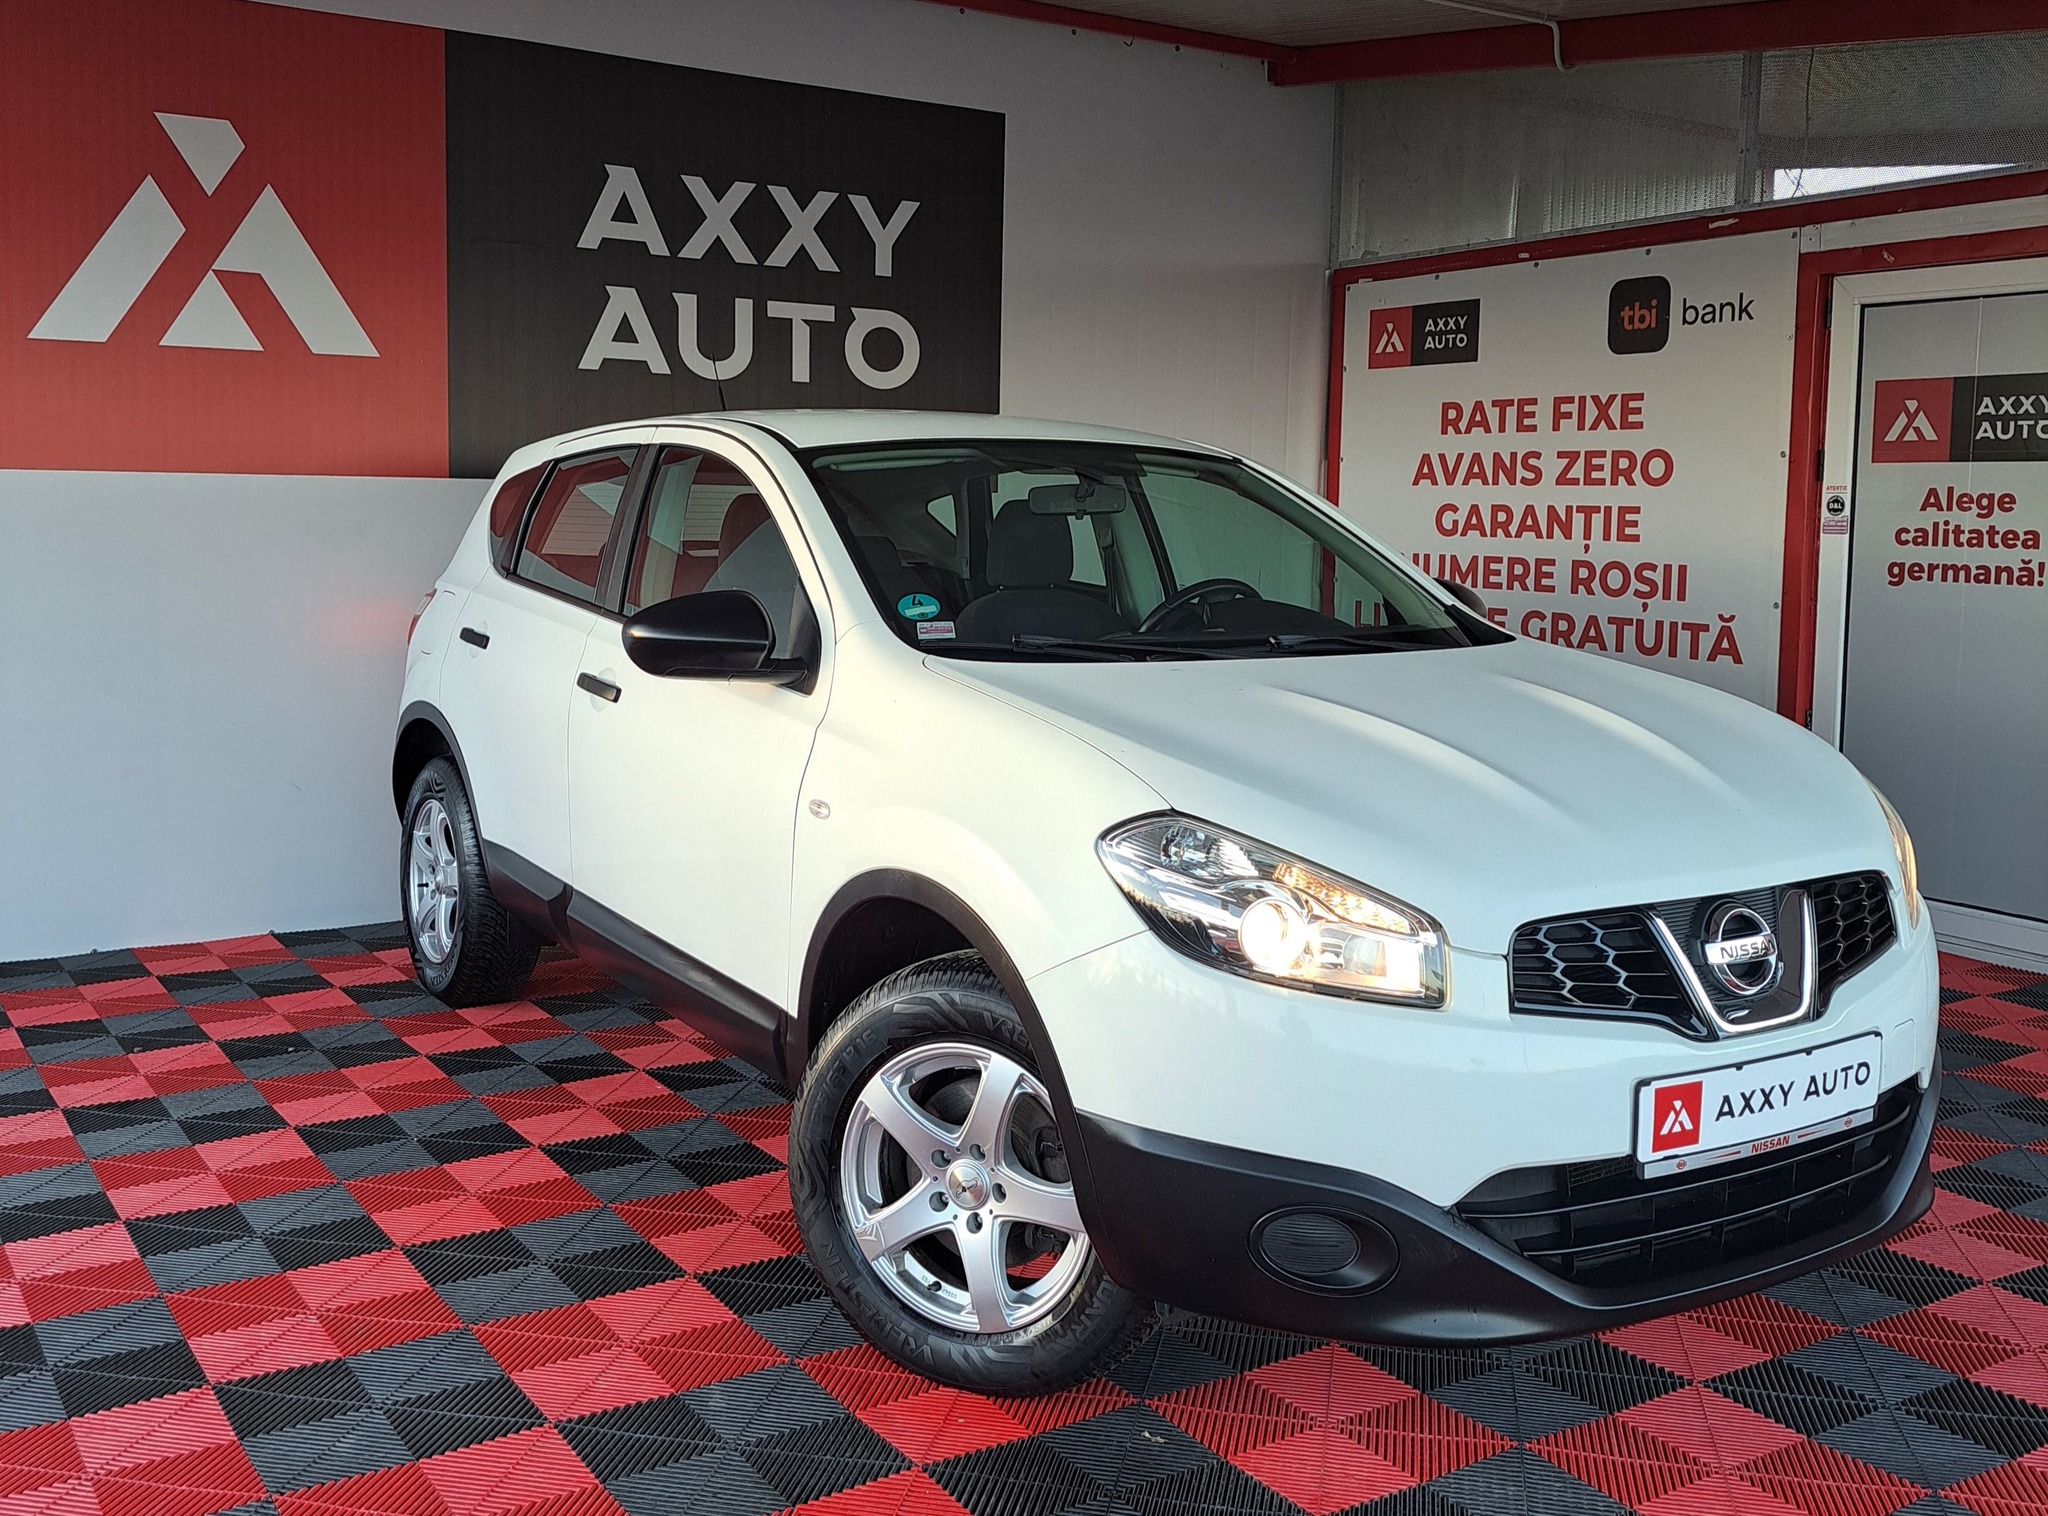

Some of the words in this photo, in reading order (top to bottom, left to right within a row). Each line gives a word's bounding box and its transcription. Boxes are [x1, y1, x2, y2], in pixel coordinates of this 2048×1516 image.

[577, 163, 920, 277] AXXY
[1424, 315, 1468, 333] AXXY
[1620, 299, 1658, 331] tbi
[1681, 292, 1755, 326] bank
[578, 285, 920, 390] AUTO
[1424, 333, 1468, 350] AUTO
[1440, 398, 1538, 435] RATE
[1551, 393, 1645, 432] FIXE
[1976, 395, 2048, 416] AXXY
[1975, 420, 2048, 440] AUTO
[1412, 450, 1544, 487] AVANS
[1554, 449, 1675, 487] ZERO
[1919, 486, 2017, 519] Alege
[1435, 503, 1642, 554] GARANȚIE
[1894, 520, 2041, 550] calitatea
[1570, 559, 1688, 613] ROȘII
[1887, 559, 2046, 587] germană!
[1520, 609, 1744, 665] GRATUITĂ
[1720, 938, 1775, 959] NISSAN
[1715, 1080, 1796, 1123] AXXY
[1803, 1061, 1871, 1101] AUTO
[1751, 1135, 1791, 1154] NISSAN
